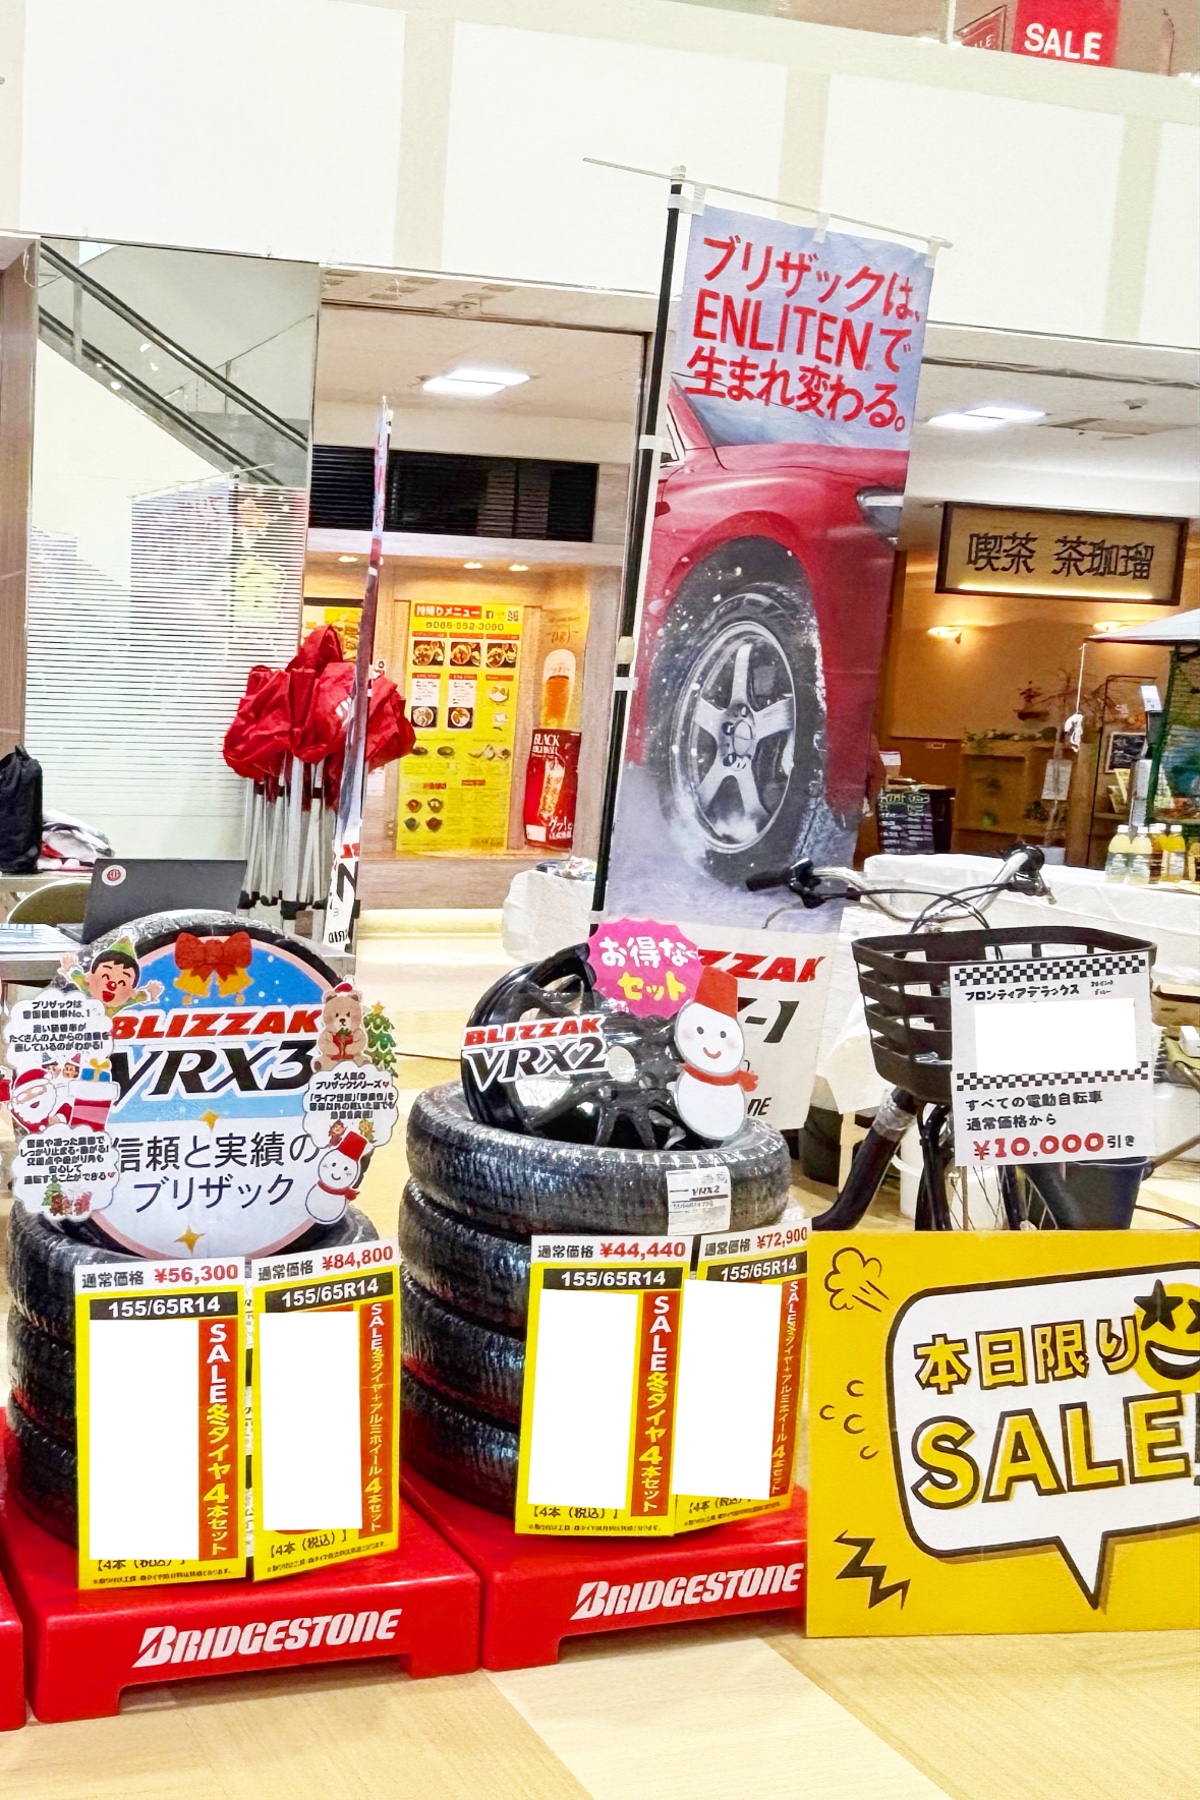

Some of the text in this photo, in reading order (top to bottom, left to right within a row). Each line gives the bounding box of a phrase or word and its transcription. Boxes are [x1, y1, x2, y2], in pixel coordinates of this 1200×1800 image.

[1024, 22, 1102, 61] SALE
[704, 235, 921, 323] ブリザックは、
[684, 345, 906, 432] 生まれ変わる。
[967, 531, 1039, 576] 喫茶
[617, 973, 687, 1001] セット
[112, 1010, 322, 1039] BLIZZAK
[463, 1017, 603, 1047] BLIZZAK
[110, 1040, 317, 1106] VRX3
[465, 1037, 608, 1087] VRX2
[965, 1090, 1103, 1111] すべての電動自転車
[966, 1113, 1057, 1132] 通常価格から
[133, 1173, 295, 1213] ブリザック
[538, 1242, 686, 1261] 通常価格 ¥44,440
[705, 1226, 808, 1256] 通常価格 ¥72,900
[81, 1264, 239, 1288] 通常価格 ¥56,300
[257, 1245, 393, 1281] 通常価格 ¥84,800
[721, 1257, 797, 1281] 155/65R14
[281, 1277, 379, 1308] 155/65R14
[561, 1271, 666, 1287] 155/65R14
[108, 1296, 221, 1318] 155/65R14
[913, 1314, 1140, 1395] 本日限り
[570, 1562, 804, 1621] BRIDGESTONE
[132, 1608, 402, 1669] BRIDGESTONE
